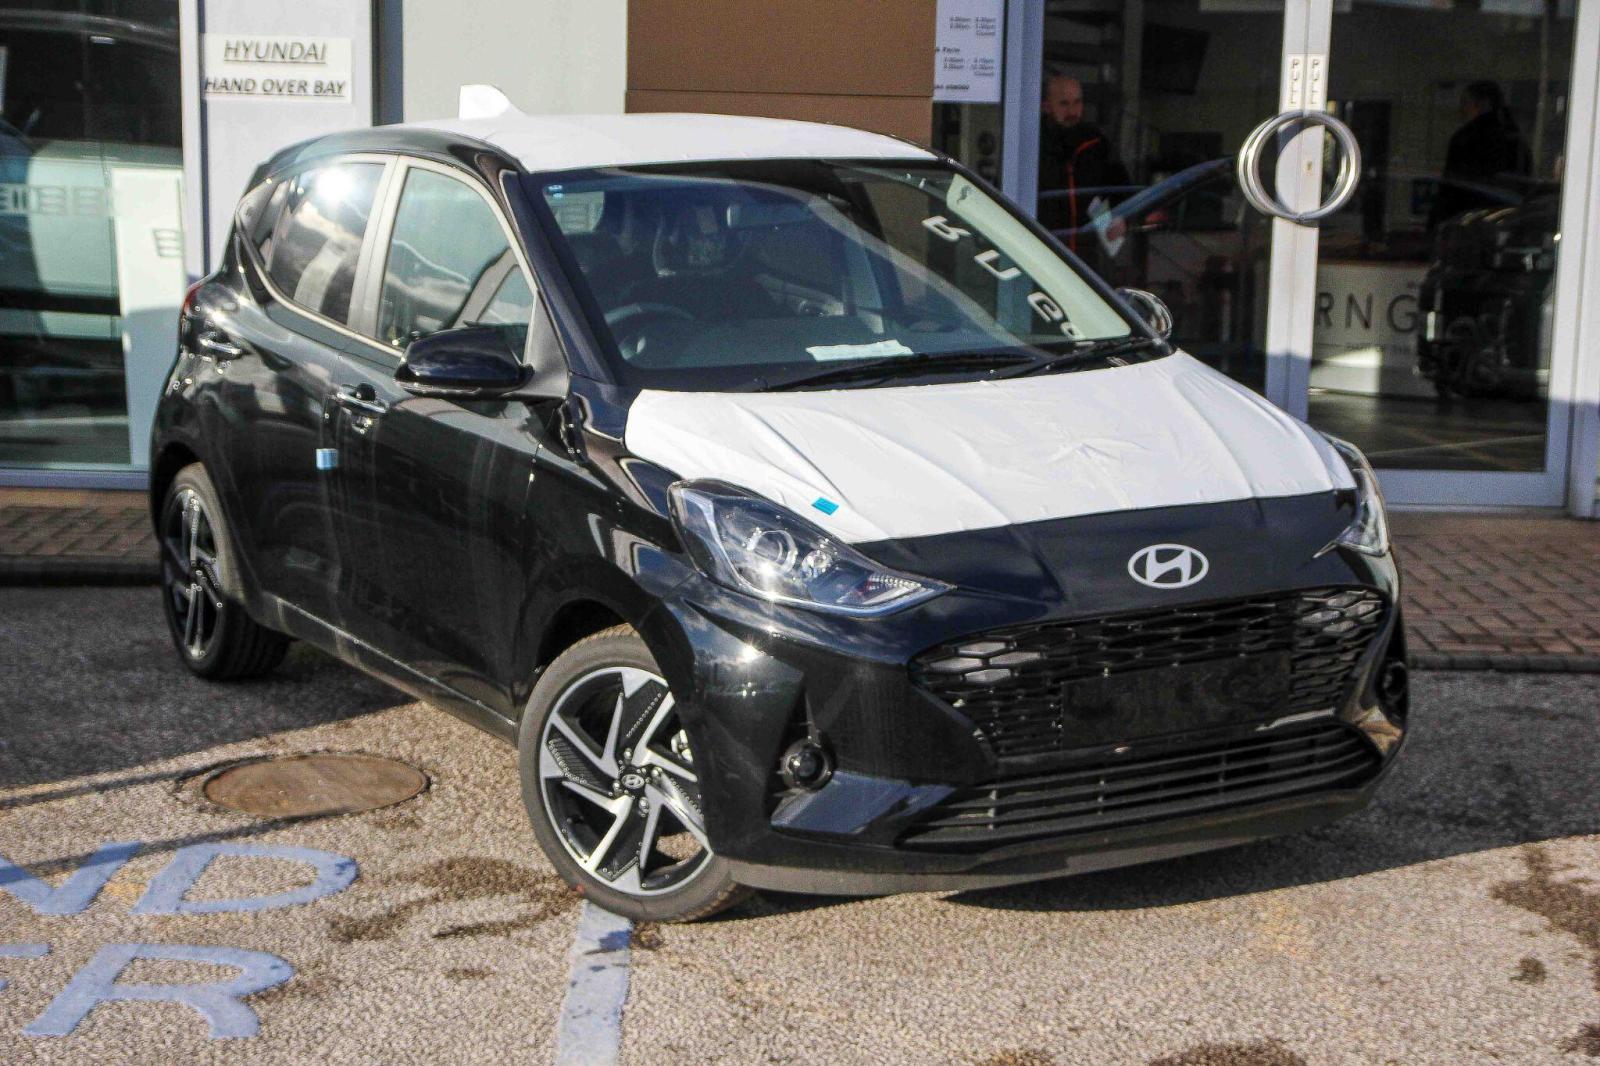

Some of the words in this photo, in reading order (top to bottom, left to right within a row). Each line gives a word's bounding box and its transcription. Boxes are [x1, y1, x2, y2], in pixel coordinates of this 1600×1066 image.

[224, 39, 328, 62] HYUNDAI
[205, 76, 256, 92] HAND
[262, 78, 308, 94] OVER
[313, 80, 346, 95] BAY
[1290, 58, 1300, 105] PULL
[1310, 58, 1320, 105] PULL
